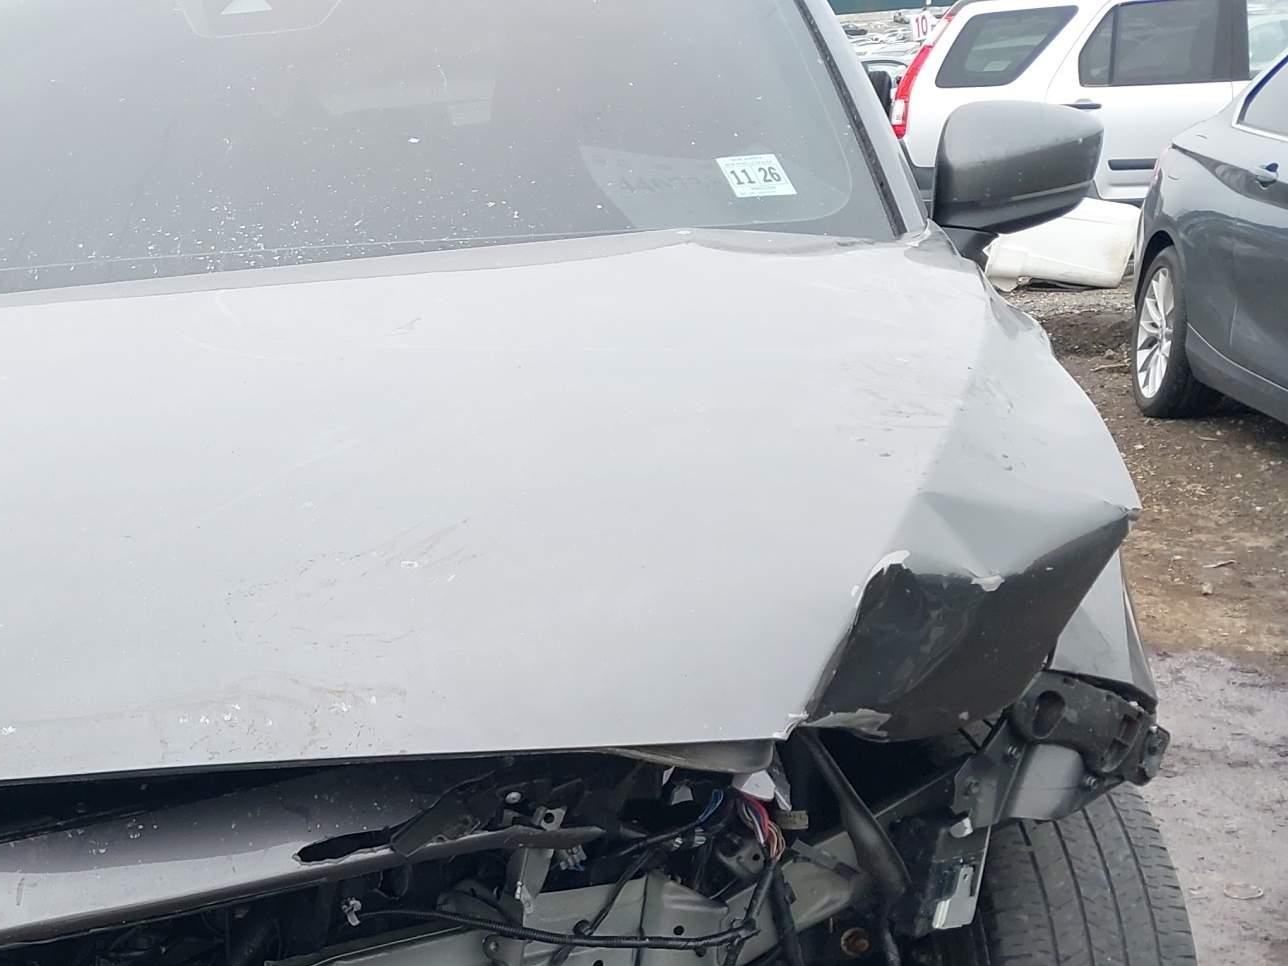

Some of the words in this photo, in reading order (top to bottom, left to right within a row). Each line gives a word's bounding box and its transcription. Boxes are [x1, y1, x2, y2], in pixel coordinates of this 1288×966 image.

[915, 15, 928, 38] 10
[730, 169, 756, 185] 11
[758, 166, 782, 183] 26
